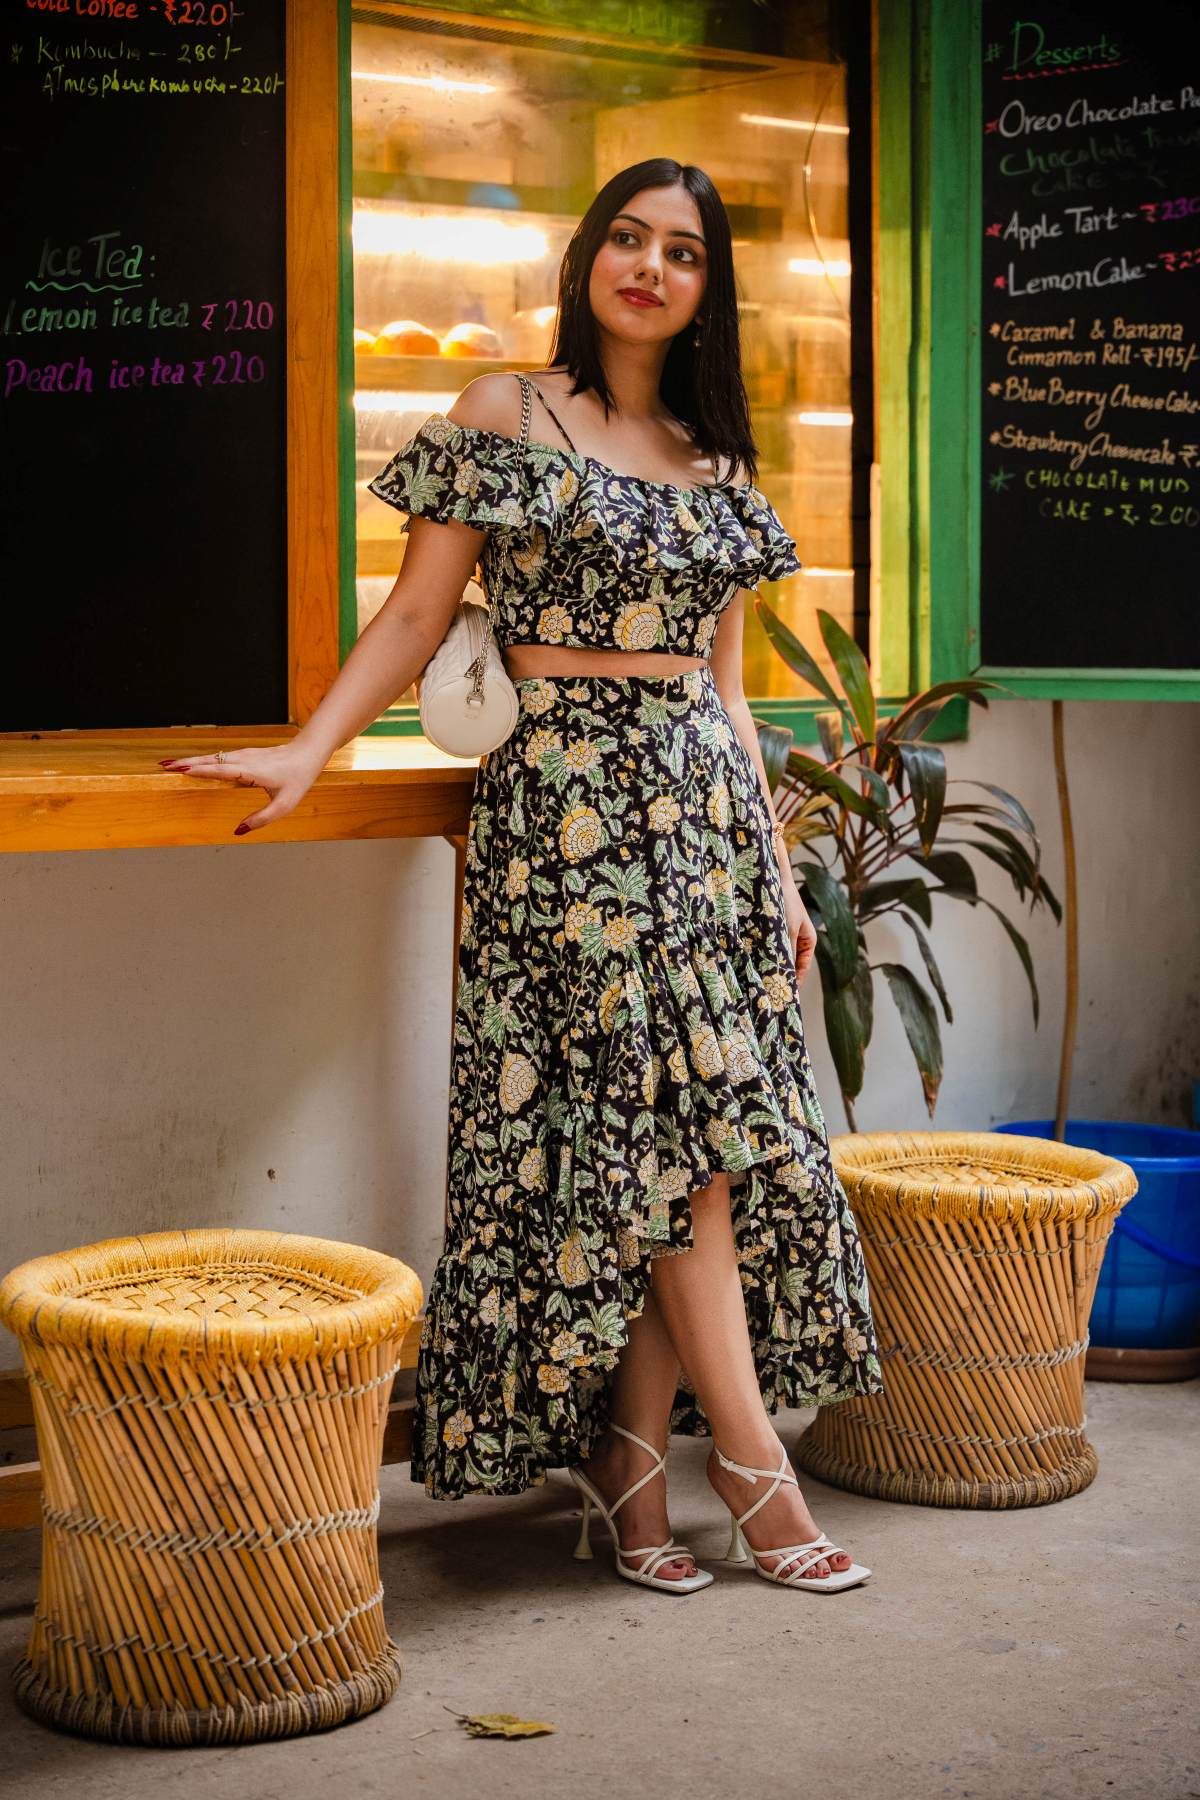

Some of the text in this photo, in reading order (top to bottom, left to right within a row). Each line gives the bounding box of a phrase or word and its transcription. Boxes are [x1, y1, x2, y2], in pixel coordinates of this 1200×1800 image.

[75, 0, 141, 19] Coffee
[1006, 21, 1121, 71] Desserts
[999, 99, 1062, 138] Oreo
[1065, 93, 1176, 128] Chocolate
[1003, 210, 1063, 251] Apple
[37, 238, 82, 279] Ice
[3, 299, 98, 336] Lemon
[1001, 317, 1076, 343] Caramel
[1112, 316, 1185, 342] Banana
[1007, 345, 1097, 368] Cinnamon
